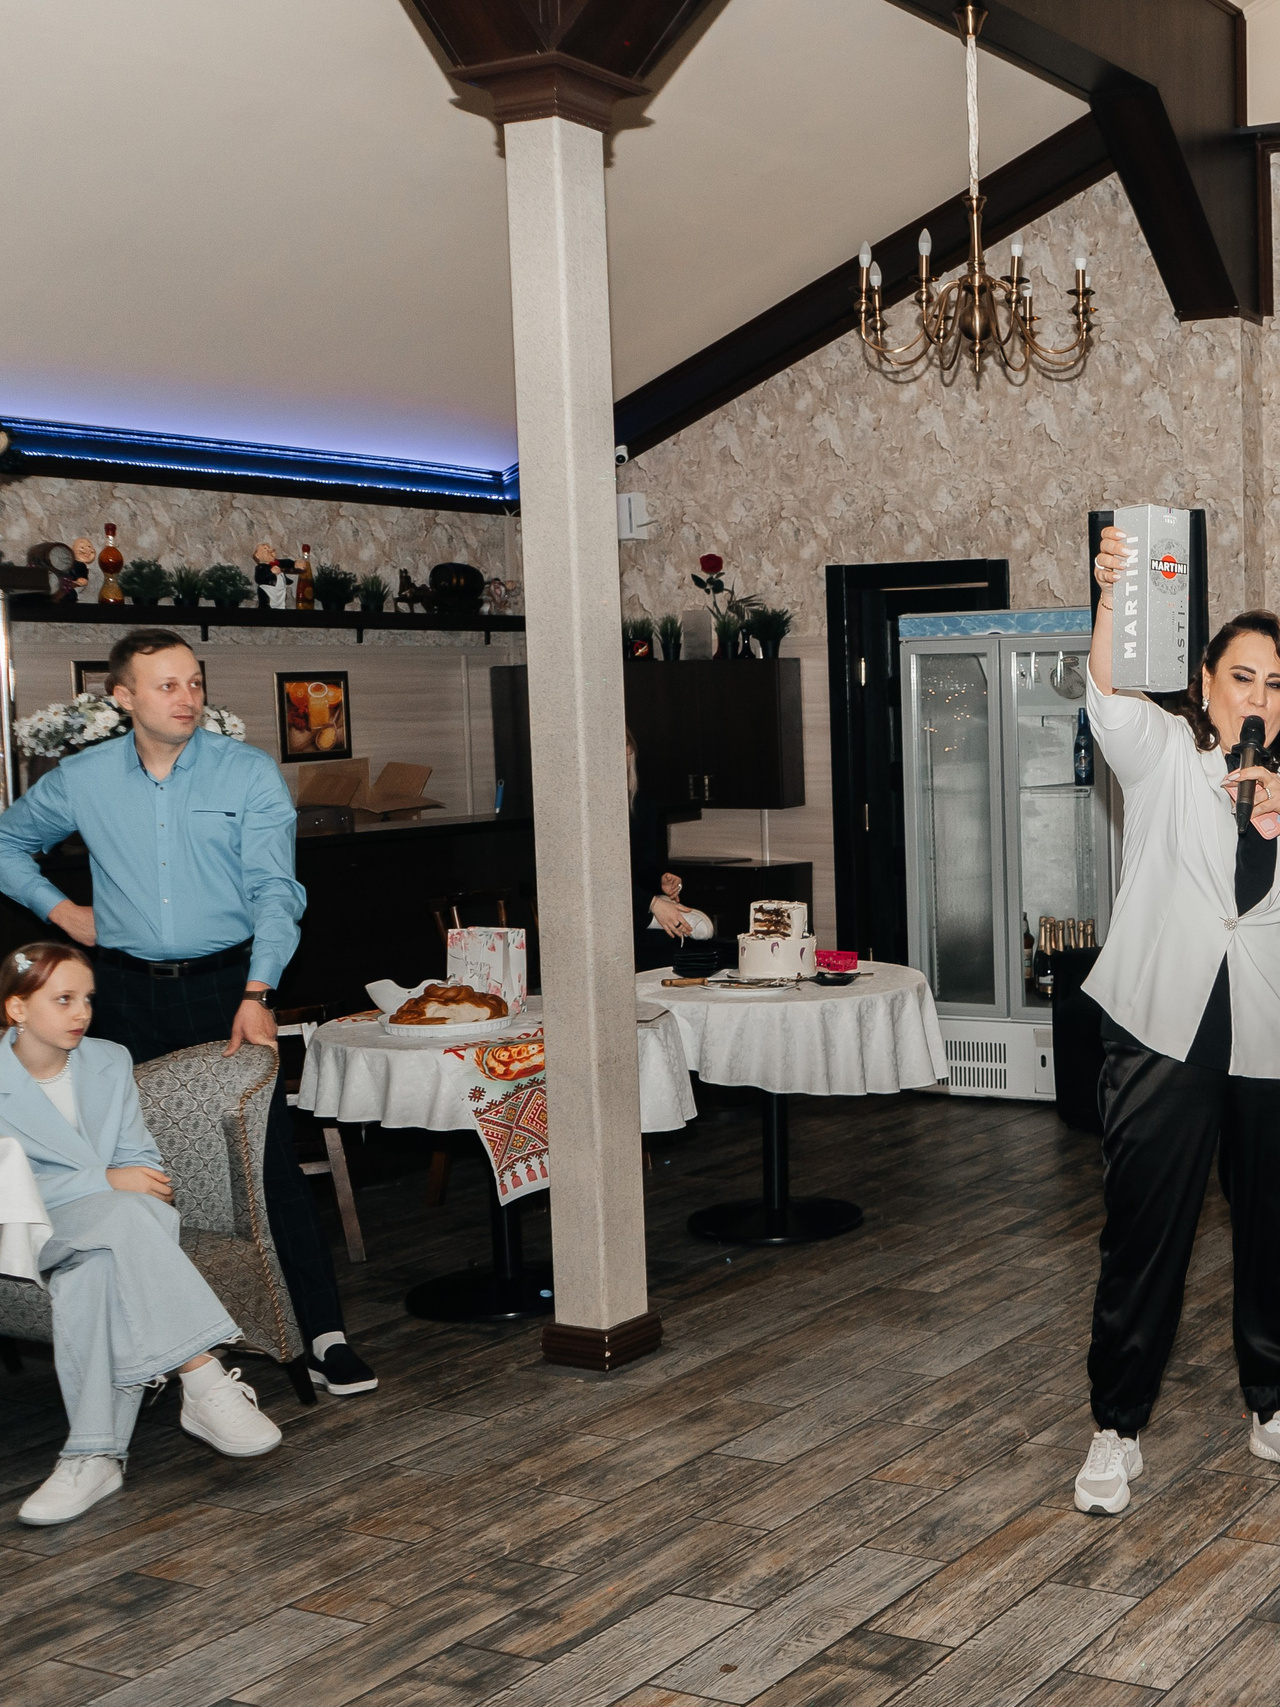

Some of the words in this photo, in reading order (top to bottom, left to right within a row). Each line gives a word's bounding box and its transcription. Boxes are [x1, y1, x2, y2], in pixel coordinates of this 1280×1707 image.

[1151, 560, 1187, 574] MARTINI
[1124, 536, 1139, 659] MARTINI
[1177, 611, 1186, 664] ASTI
